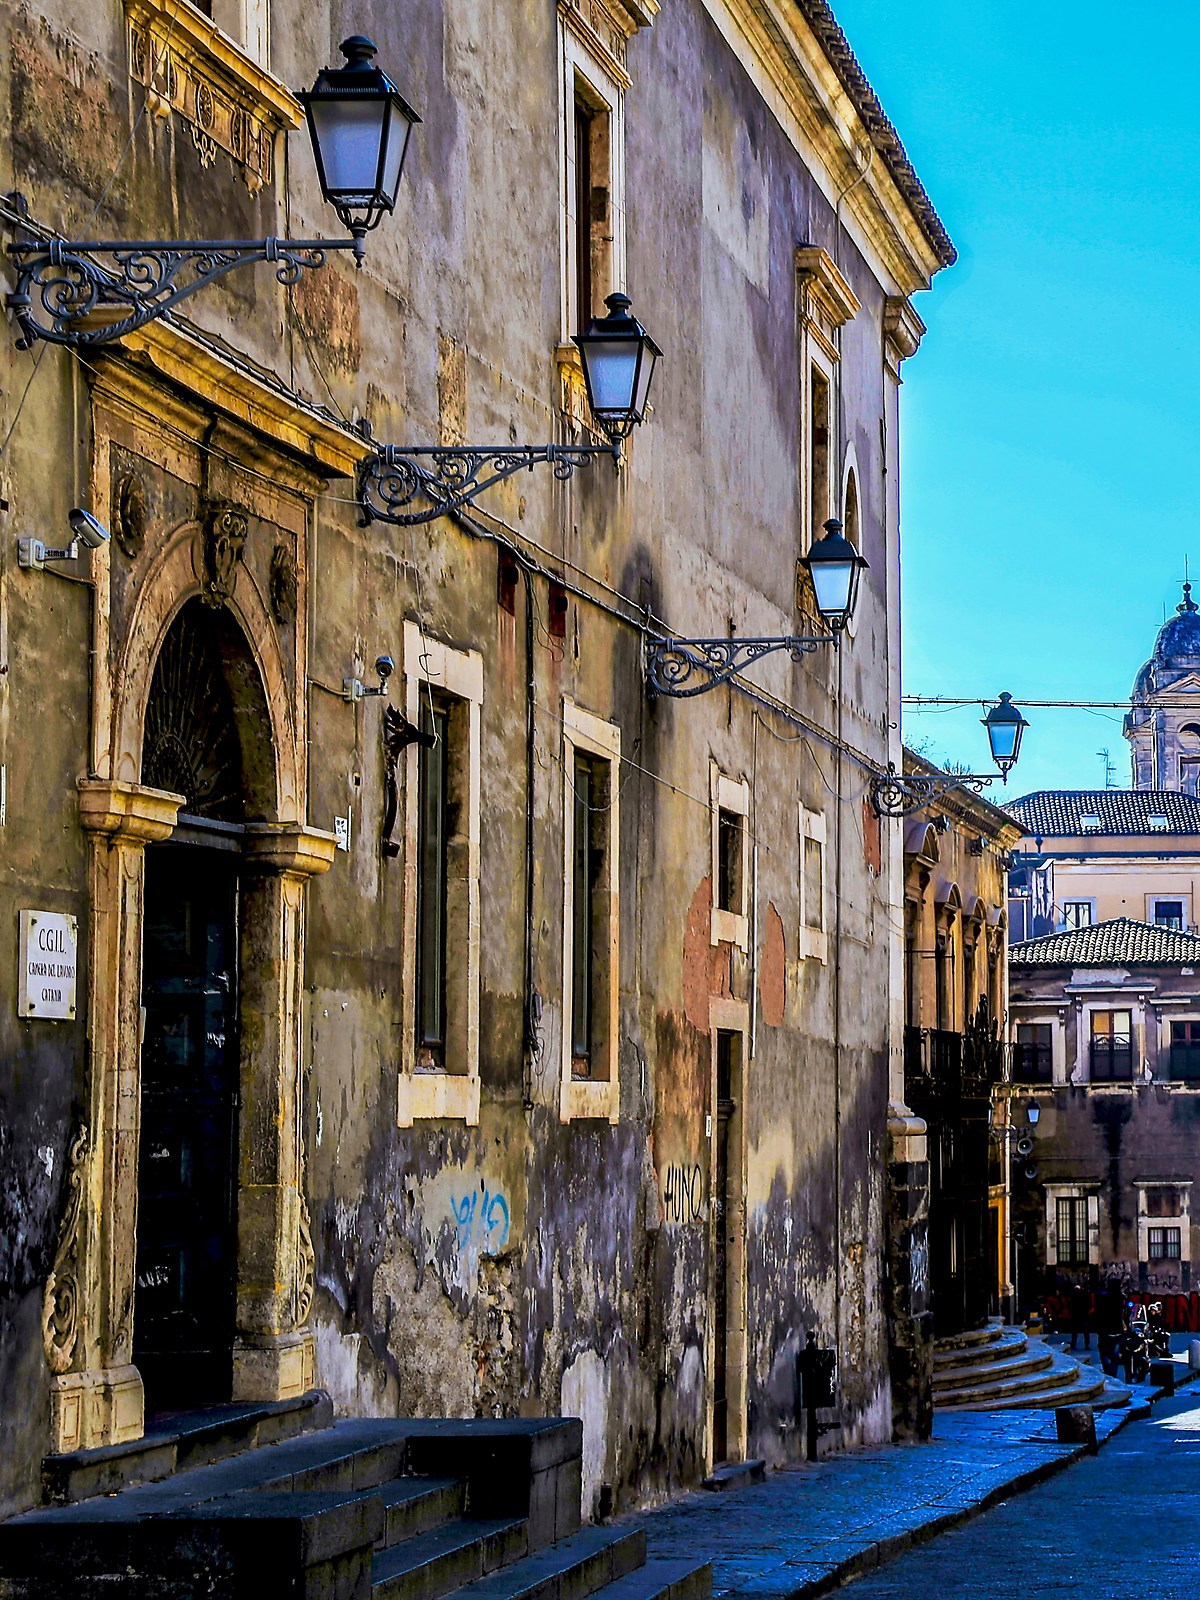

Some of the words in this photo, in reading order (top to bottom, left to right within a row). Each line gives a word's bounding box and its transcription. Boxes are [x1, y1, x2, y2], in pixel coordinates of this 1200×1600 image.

[28, 962, 47, 977] CAMERA
[48, 963, 56, 978] DEL
[57, 964, 75, 979] LAVORO
